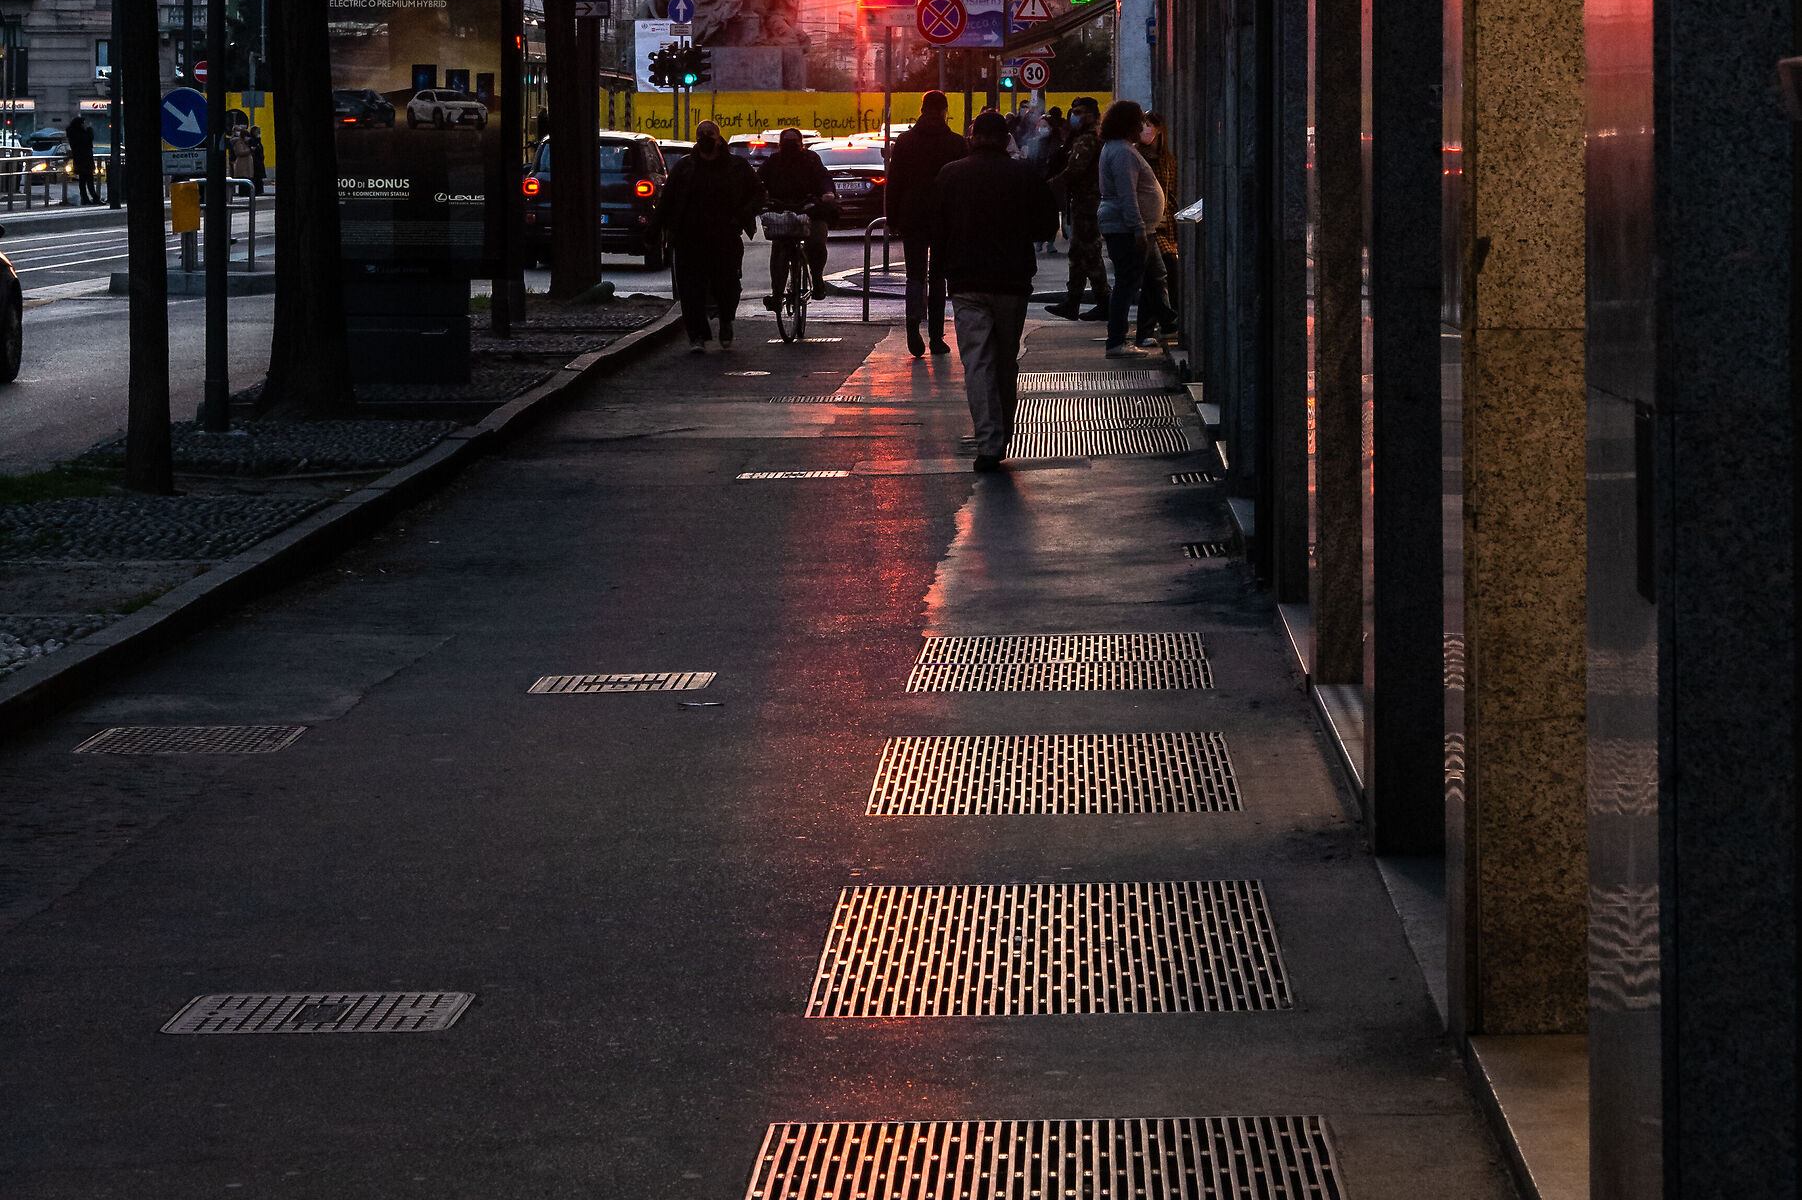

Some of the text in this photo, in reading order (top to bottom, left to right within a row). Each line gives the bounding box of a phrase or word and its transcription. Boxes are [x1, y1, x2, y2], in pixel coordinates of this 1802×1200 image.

[329, 0, 447, 8] ELECTRIC O PREMIUM HYBRID
[1026, 66, 1044, 80] 30
[645, 110, 674, 129] dear
[713, 112, 743, 128] start
[747, 110, 769, 128] the
[777, 115, 801, 127] most
[367, 178, 410, 188] BONUS
